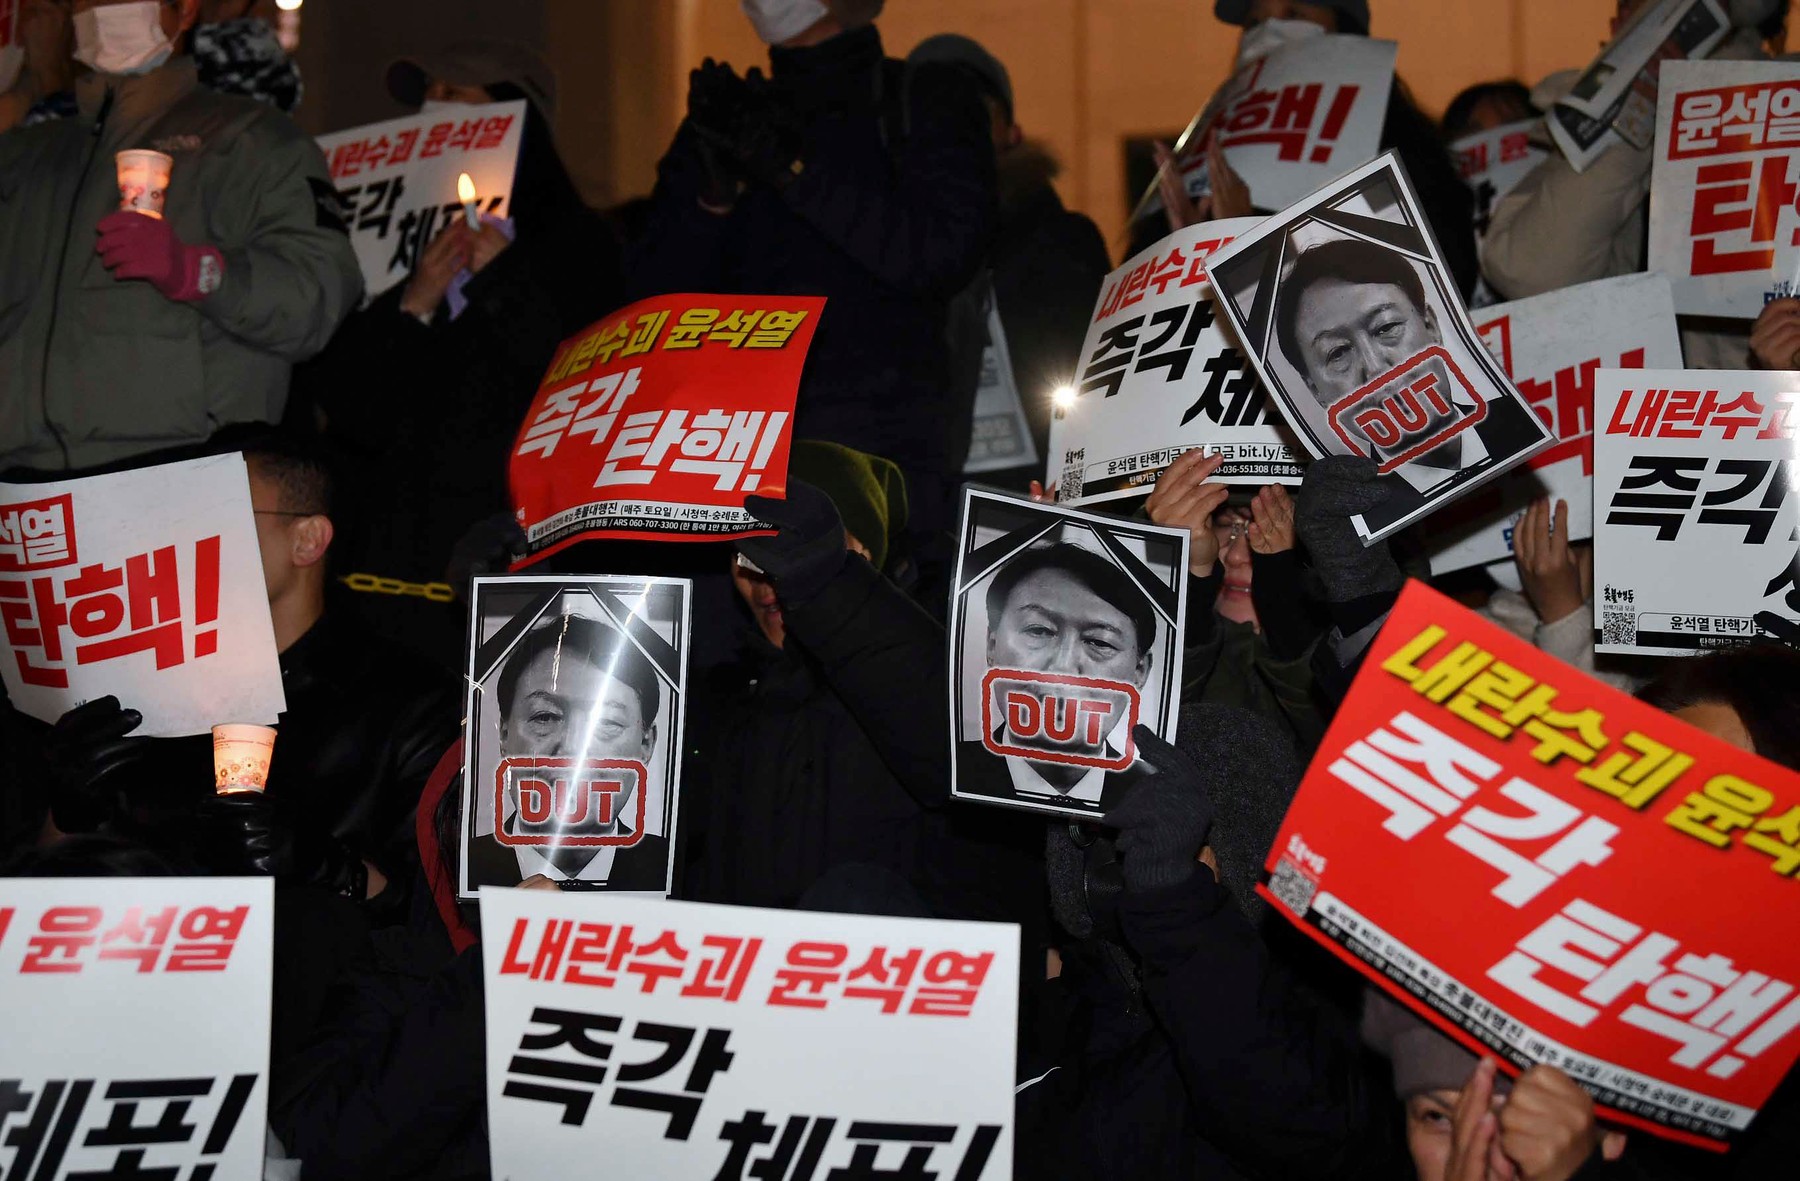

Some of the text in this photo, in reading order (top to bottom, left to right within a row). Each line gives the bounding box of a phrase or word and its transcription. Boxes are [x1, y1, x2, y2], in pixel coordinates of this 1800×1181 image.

[419, 114, 515, 159] 윤석열
[1690, 155, 1800, 276] 탄
[547, 308, 809, 385] 내란수괴 윤석열
[1078, 299, 1216, 398] 즉각
[517, 366, 642, 459] 즉각
[593, 409, 789, 492] 탄핵!
[1107, 457, 1137, 475] 윤석열
[1212, 463, 1269, 474] 0-036-551308
[1605, 456, 1793, 544] 즉각
[613, 519, 628, 527] ARS
[628, 518, 679, 530] 060-707-3300
[620, 504, 642, 516] (매주
[644, 505, 672, 517] 토요일
[0, 535, 221, 688] 탄핵!
[1670, 616, 1710, 632] 윤석열
[1380, 624, 1695, 810] 내란수괴
[1328, 710, 1621, 909] 즉각
[19, 906, 251, 974] 윤석열
[498, 917, 995, 1018] 내란수괴 윤석열
[1485, 898, 1800, 1081] 탄핵!
[502, 1007, 736, 1141] 즉각
